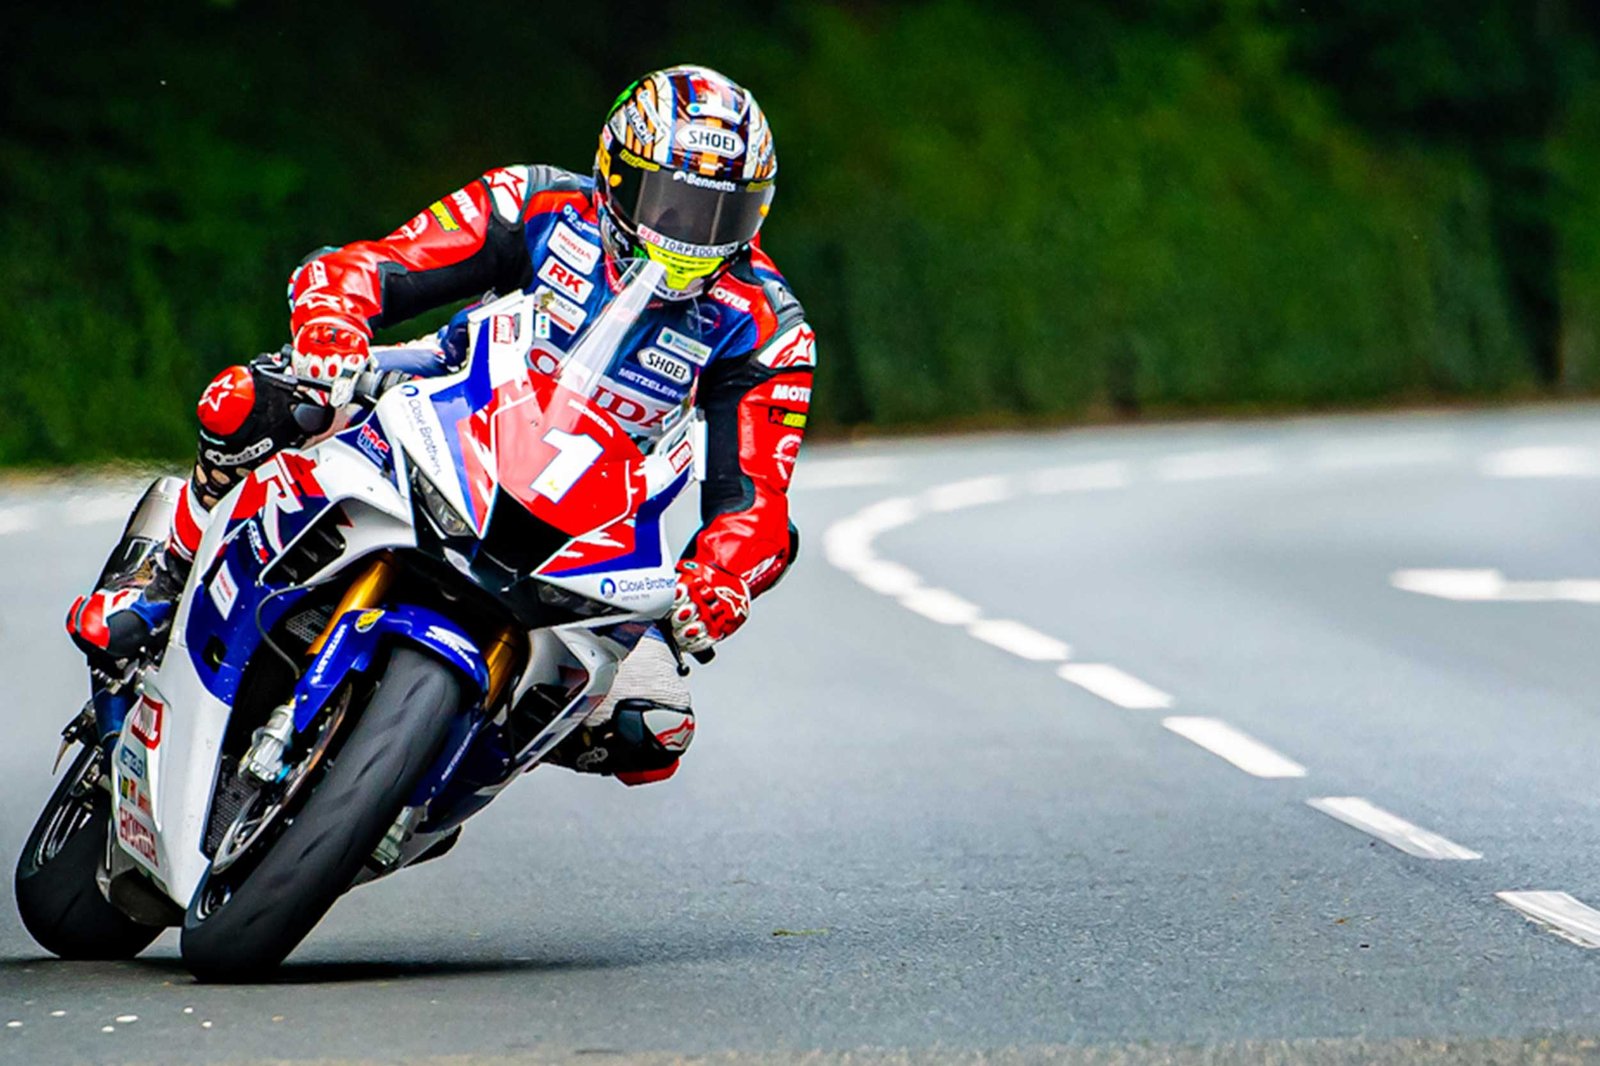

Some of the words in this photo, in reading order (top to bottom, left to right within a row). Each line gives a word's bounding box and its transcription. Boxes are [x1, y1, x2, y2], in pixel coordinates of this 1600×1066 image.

[689, 130, 735, 152] SHOEI
[687, 173, 736, 192] Bennetts
[640, 226, 662, 245] RED
[548, 262, 584, 294] RK
[648, 352, 688, 381] SHOEI
[618, 367, 678, 398] METZELER
[529, 427, 605, 505] 1
[618, 579, 644, 592] Close
